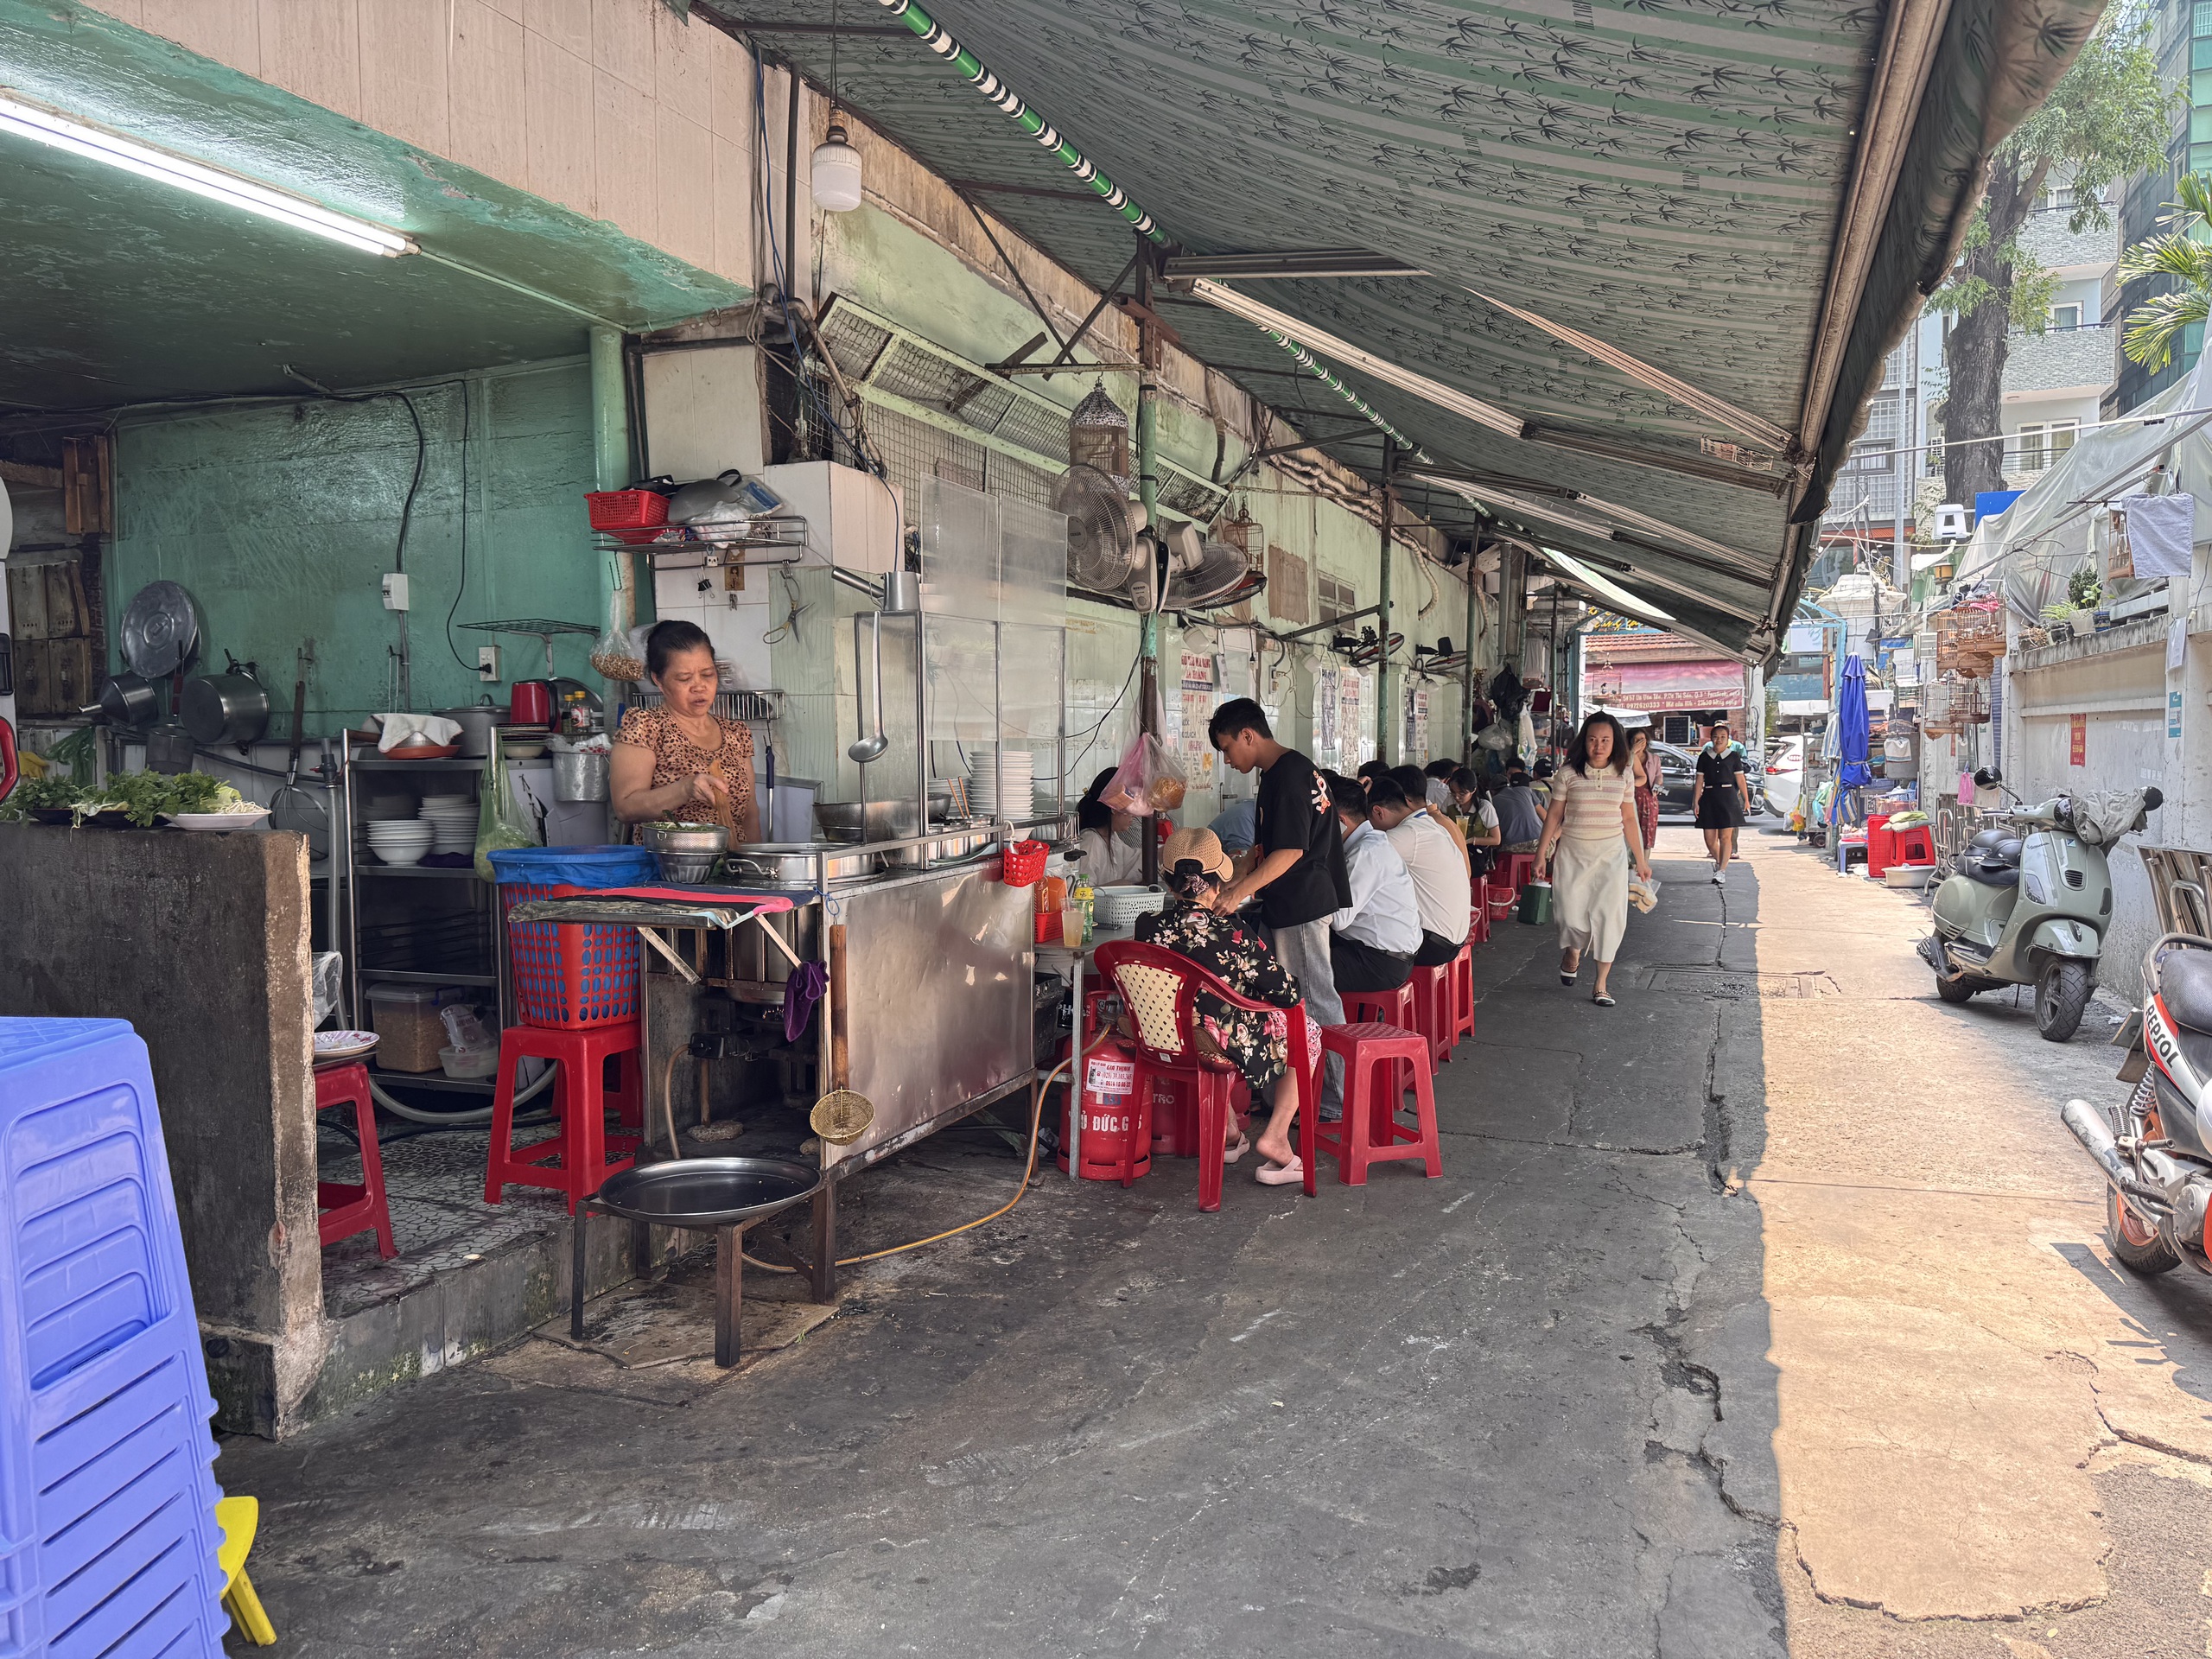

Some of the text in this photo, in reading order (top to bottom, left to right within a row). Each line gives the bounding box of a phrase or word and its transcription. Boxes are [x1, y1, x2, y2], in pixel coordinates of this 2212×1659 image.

[2145, 1003, 2179, 1069] REPSOL
[1153, 1093, 1175, 1104] TRO
[1092, 1113, 1118, 1133] ĐỨC
